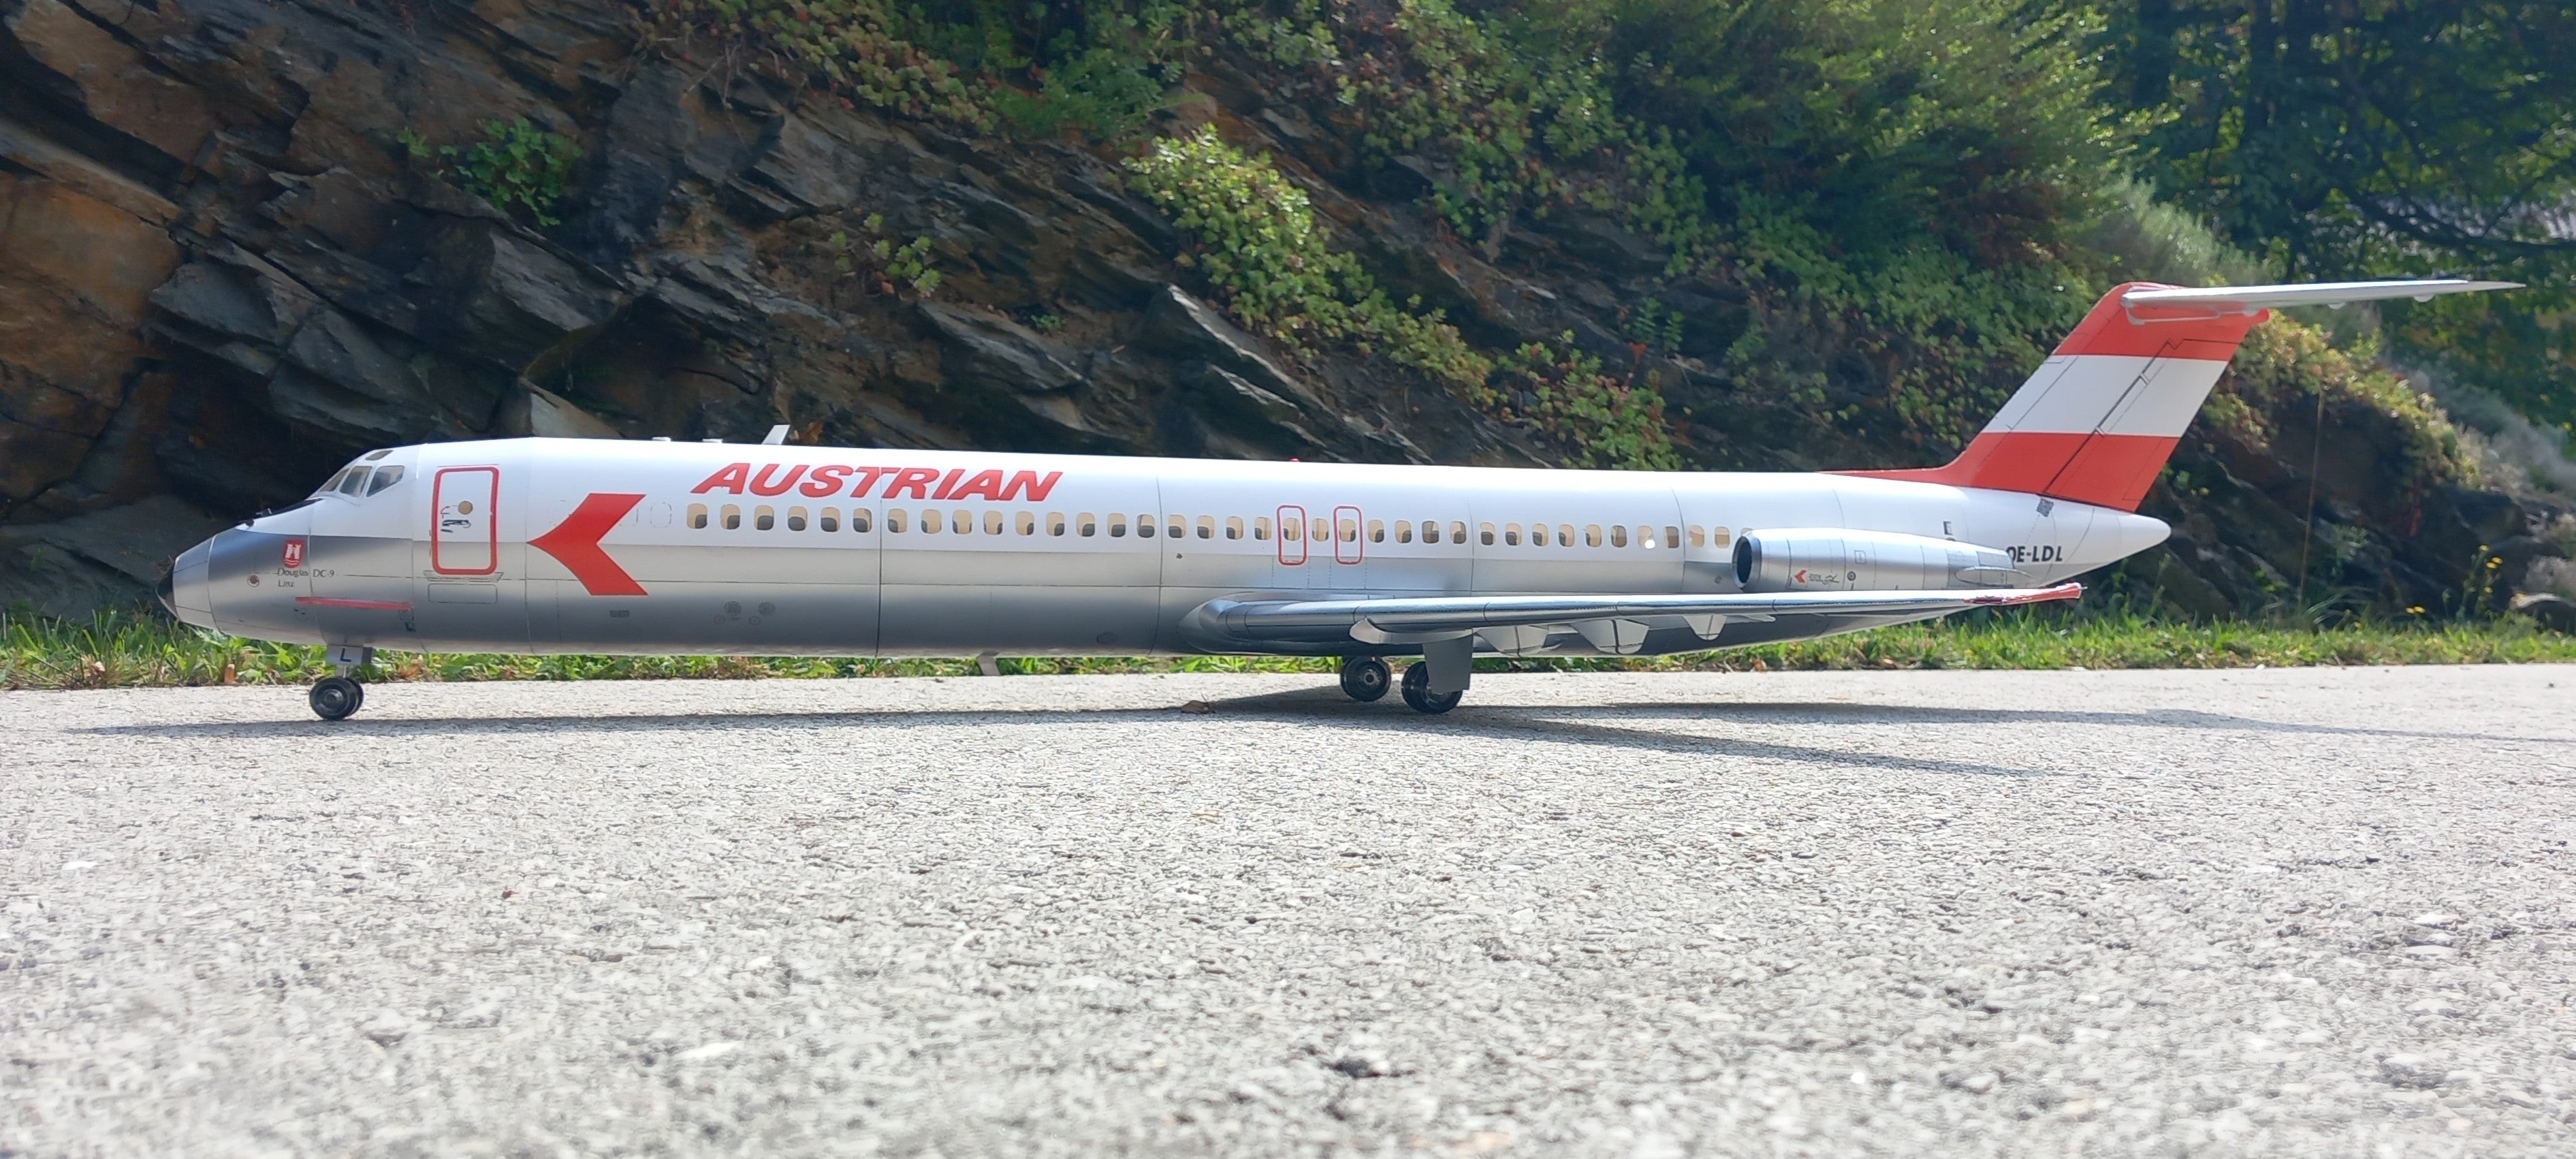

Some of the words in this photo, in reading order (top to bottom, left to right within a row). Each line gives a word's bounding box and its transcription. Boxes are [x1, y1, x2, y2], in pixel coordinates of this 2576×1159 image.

[690, 462, 1064, 502] AUSTRIAN
[2006, 545, 2063, 562] OE-LDL
[277, 568, 308, 577] Douglas
[340, 648, 351, 662] L
